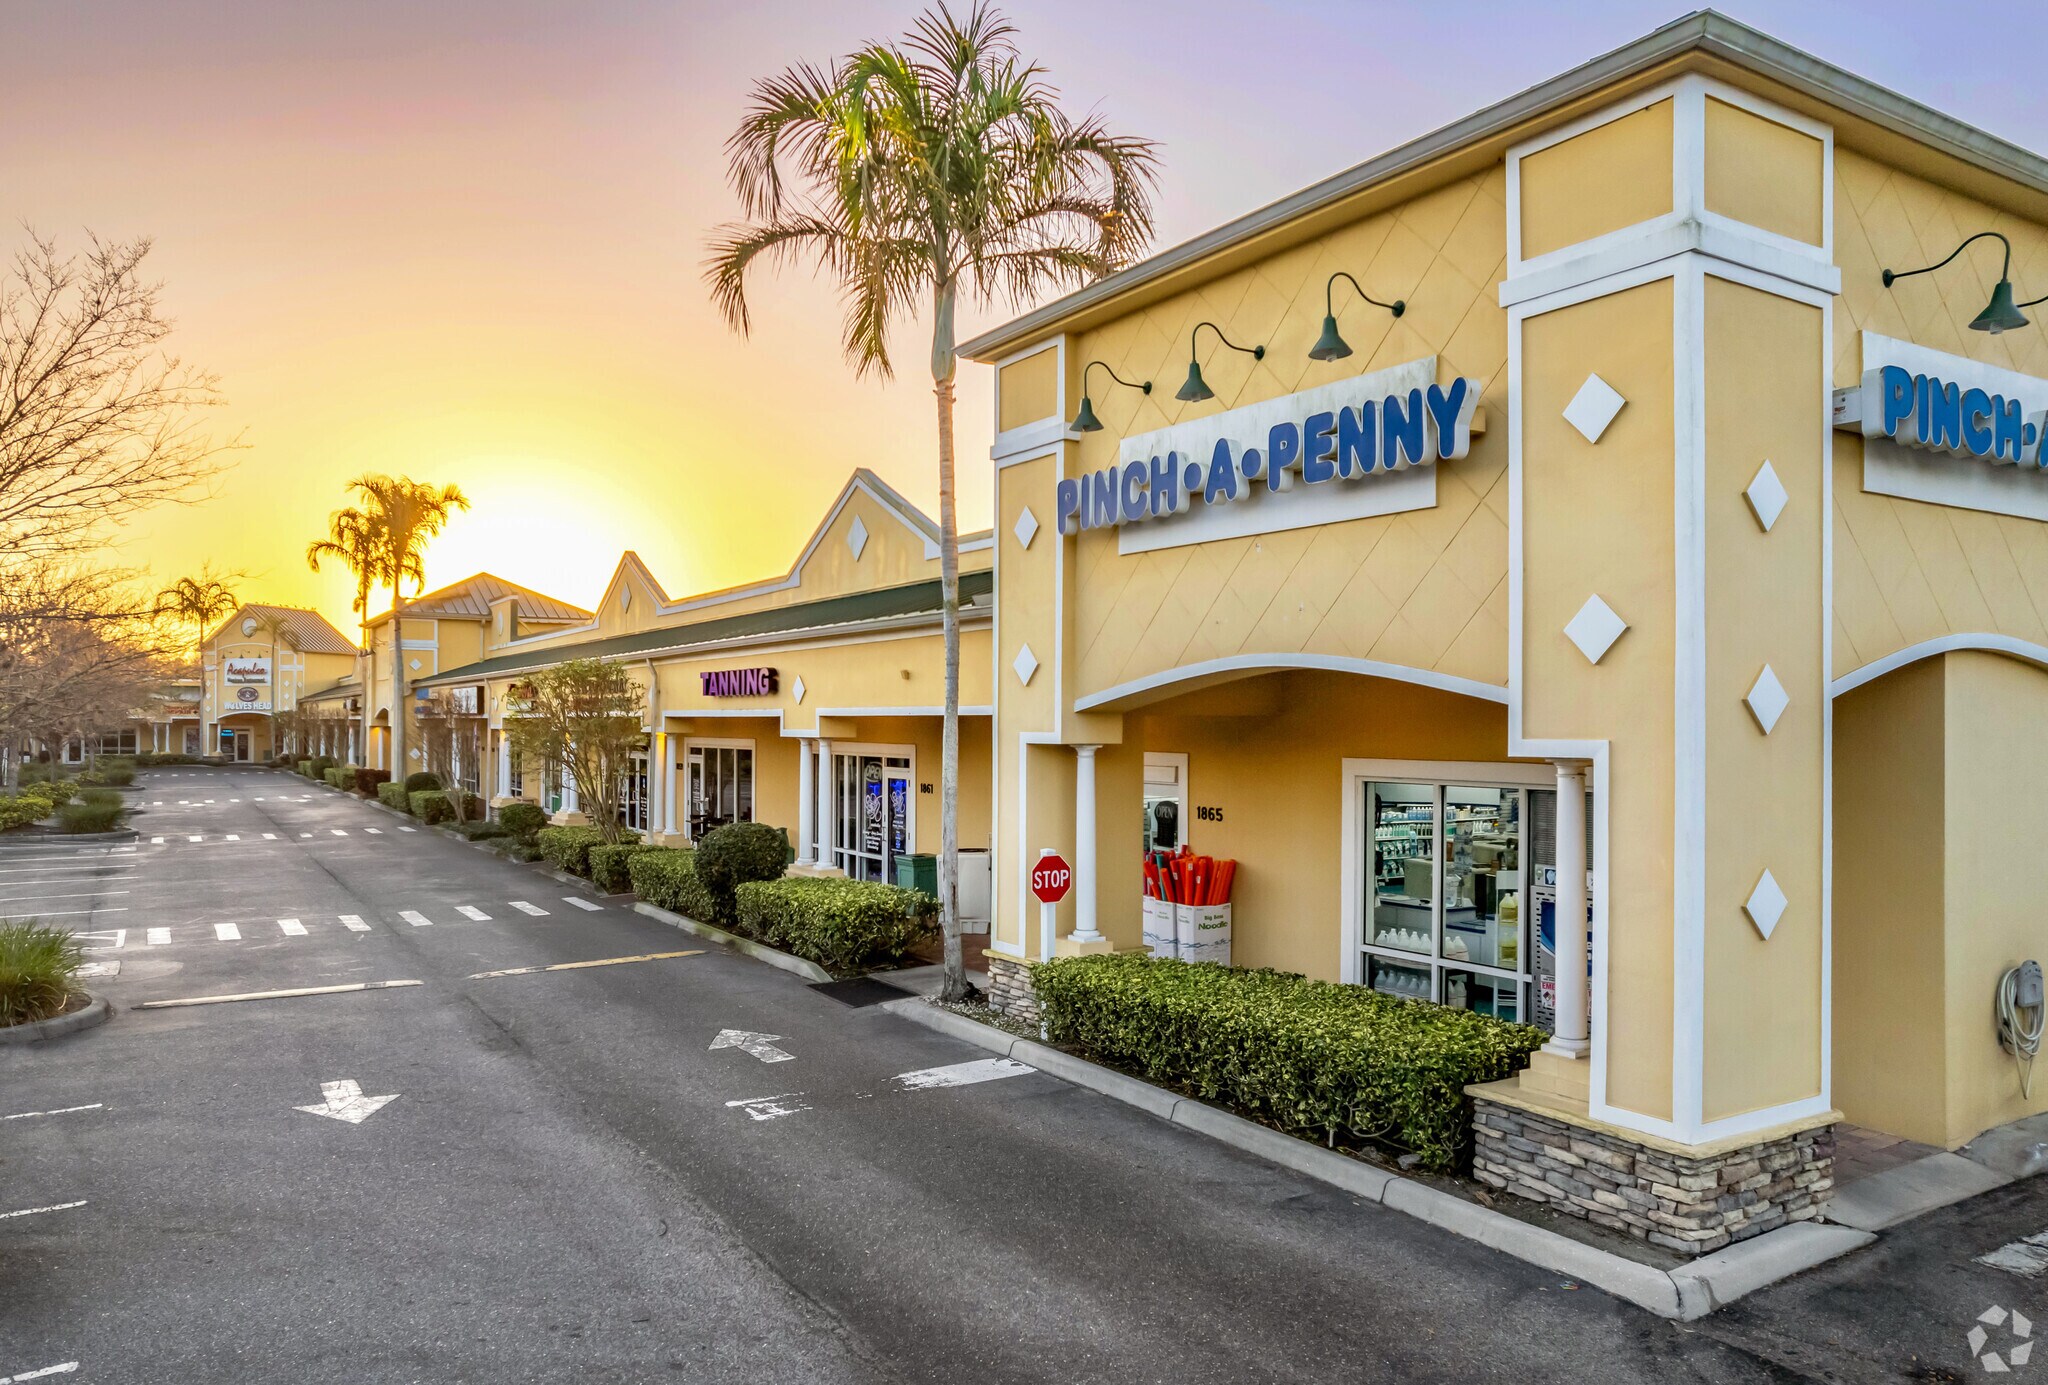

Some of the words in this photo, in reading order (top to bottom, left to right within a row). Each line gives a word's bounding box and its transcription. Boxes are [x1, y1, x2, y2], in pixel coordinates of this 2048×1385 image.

[700, 667, 772, 697] TANNING
[253, 702, 272, 710] HEAD
[920, 783, 934, 794] 1861
[1155, 804, 1174, 819] OPEN
[1197, 805, 1224, 822] 1865
[1033, 869, 1070, 890] STOP
[1198, 920, 1229, 931] Noodle
